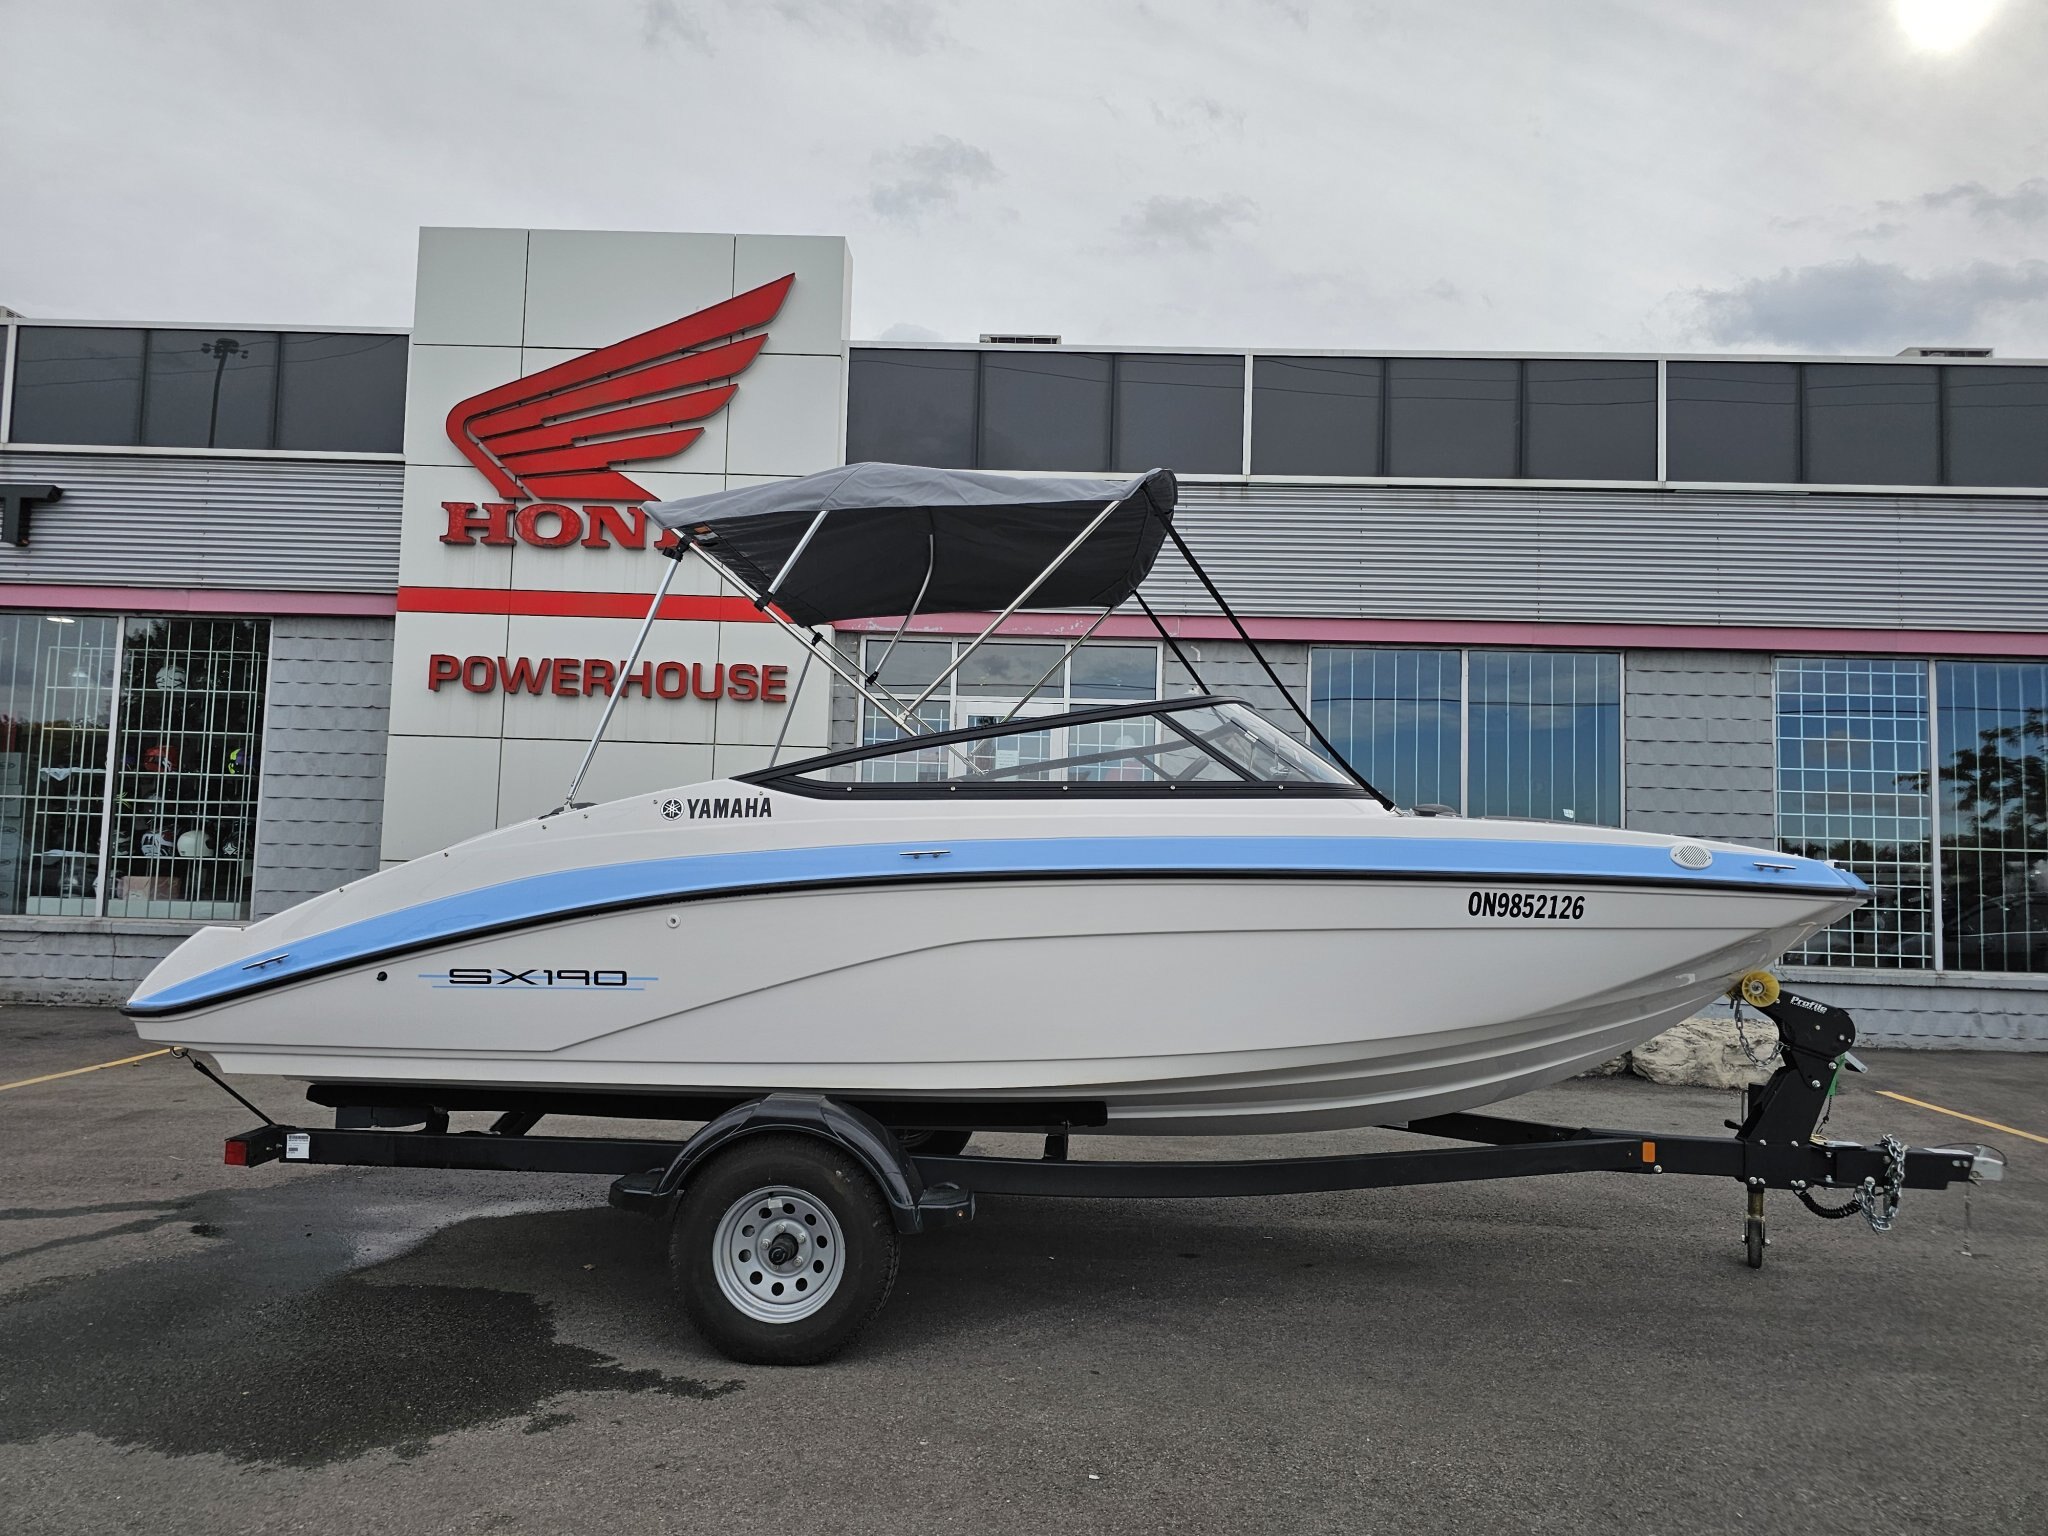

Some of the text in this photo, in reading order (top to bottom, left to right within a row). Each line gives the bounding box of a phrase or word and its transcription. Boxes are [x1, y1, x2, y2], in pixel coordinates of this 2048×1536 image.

[440, 502, 690, 550] HON
[428, 654, 788, 703] POWERHOUSE
[687, 797, 772, 819] YAMAHA
[1468, 891, 1585, 920] ON9852126
[449, 968, 627, 986] SX190
[1790, 995, 1828, 1012] Profile
